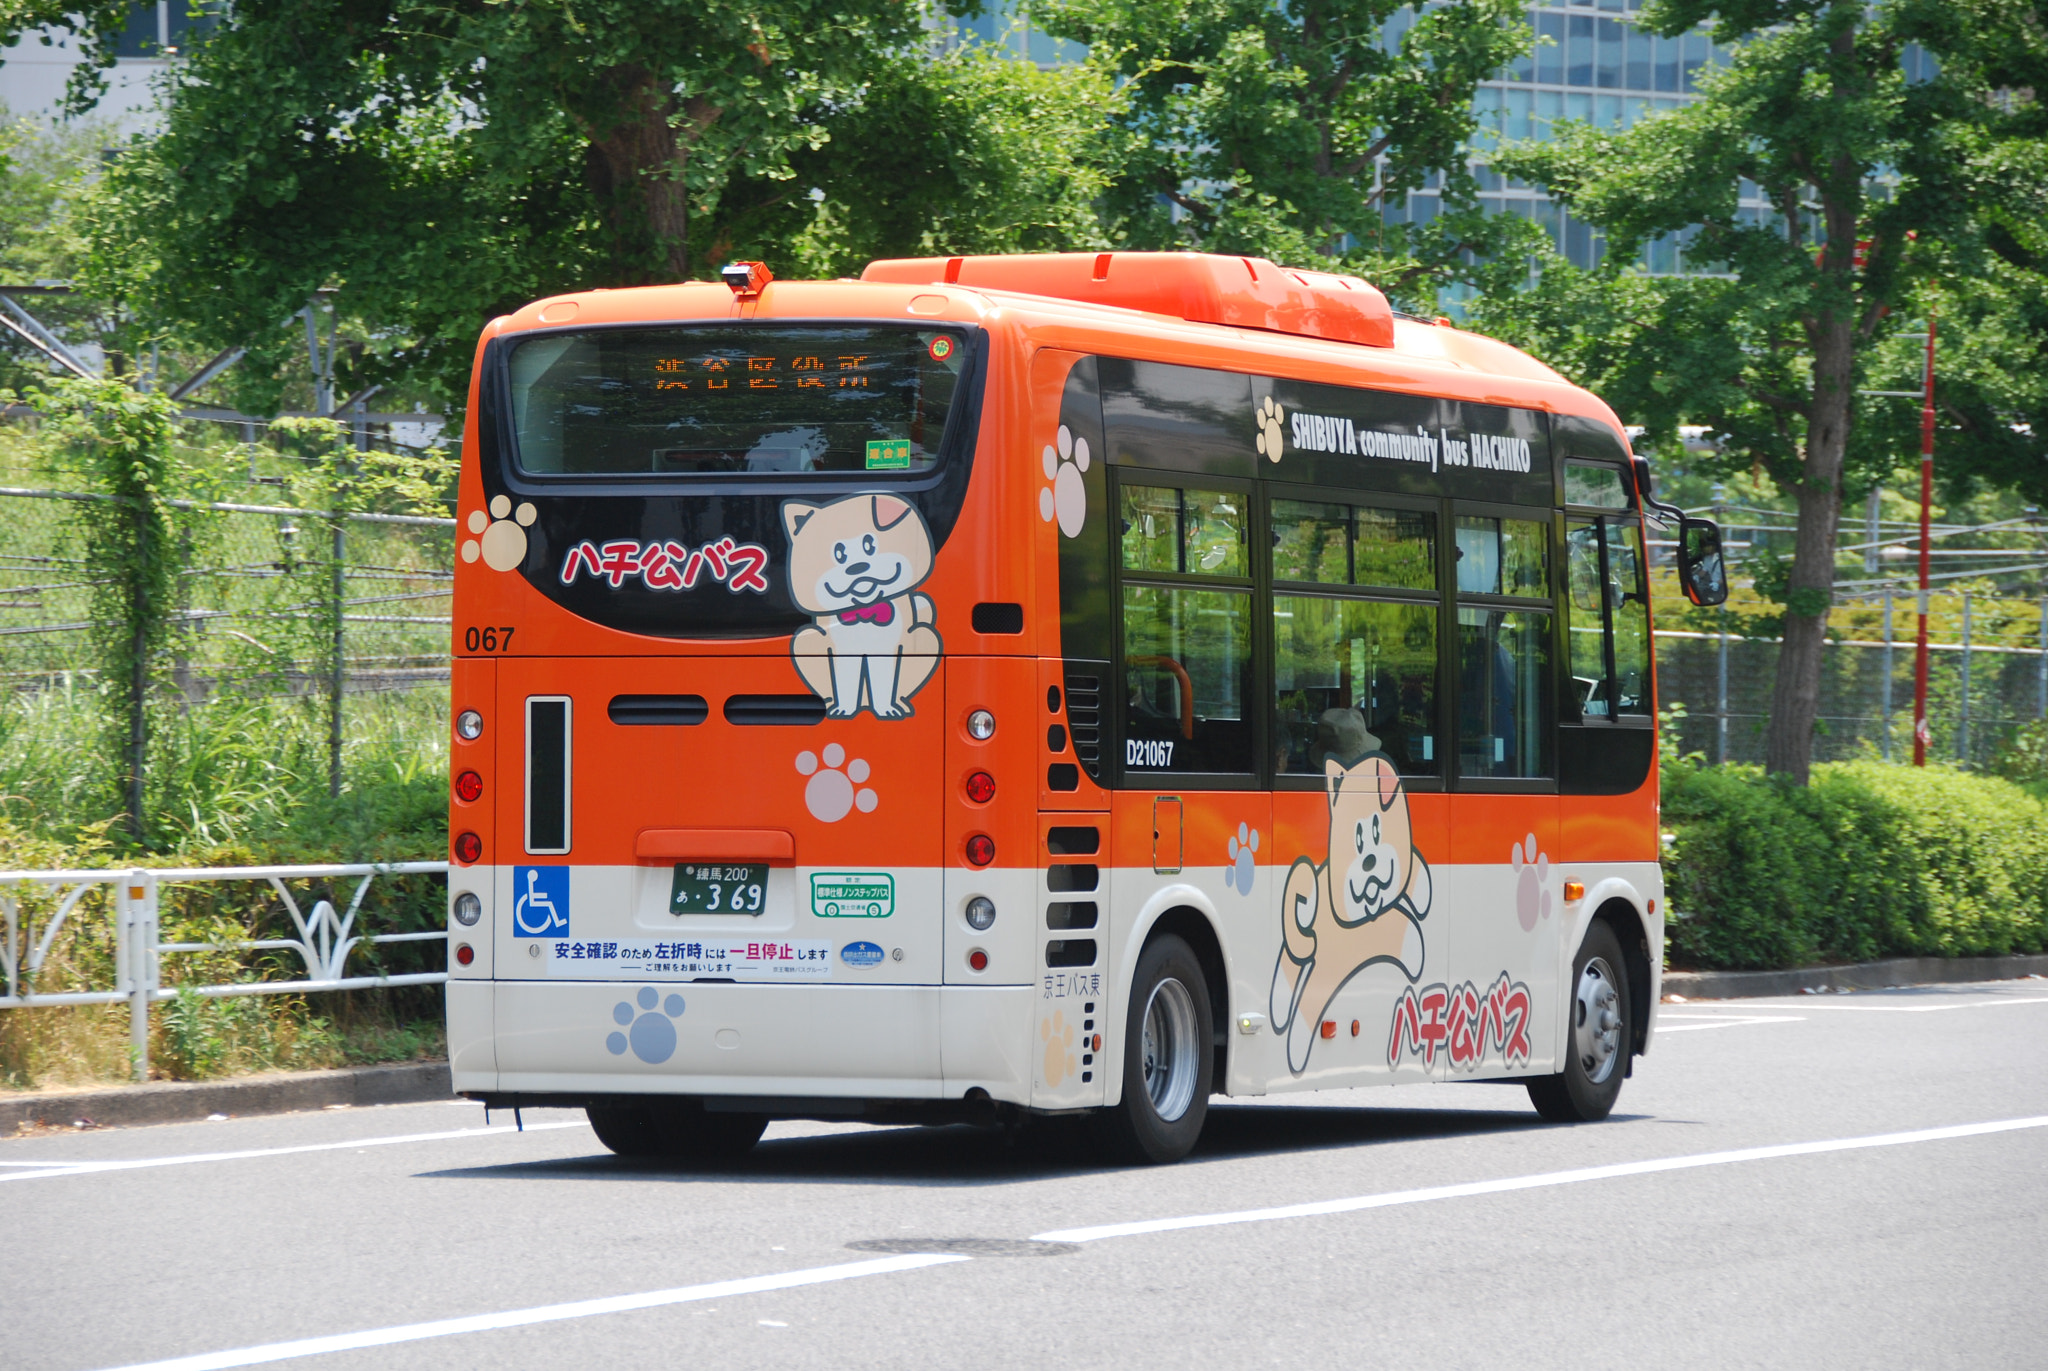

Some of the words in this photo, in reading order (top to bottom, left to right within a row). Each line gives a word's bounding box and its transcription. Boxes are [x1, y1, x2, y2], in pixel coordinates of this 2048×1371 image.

[1291, 412, 1357, 455] SHIBUYA
[1360, 425, 1438, 473] community
[1441, 428, 1469, 467] bus
[1470, 433, 1531, 473] HACHIKO
[560, 536, 768, 592] ハチ公バス
[465, 626, 515, 652] 067
[1126, 739, 1174, 767] D21067
[696, 867, 722, 881] 練馬
[724, 867, 748, 881] 200
[676, 890, 688, 904] あ
[645, 963, 732, 972] ご理解をお願いします
[1044, 973, 1101, 999] 京王バス東
[1388, 974, 1531, 1070] ハチ公バス
